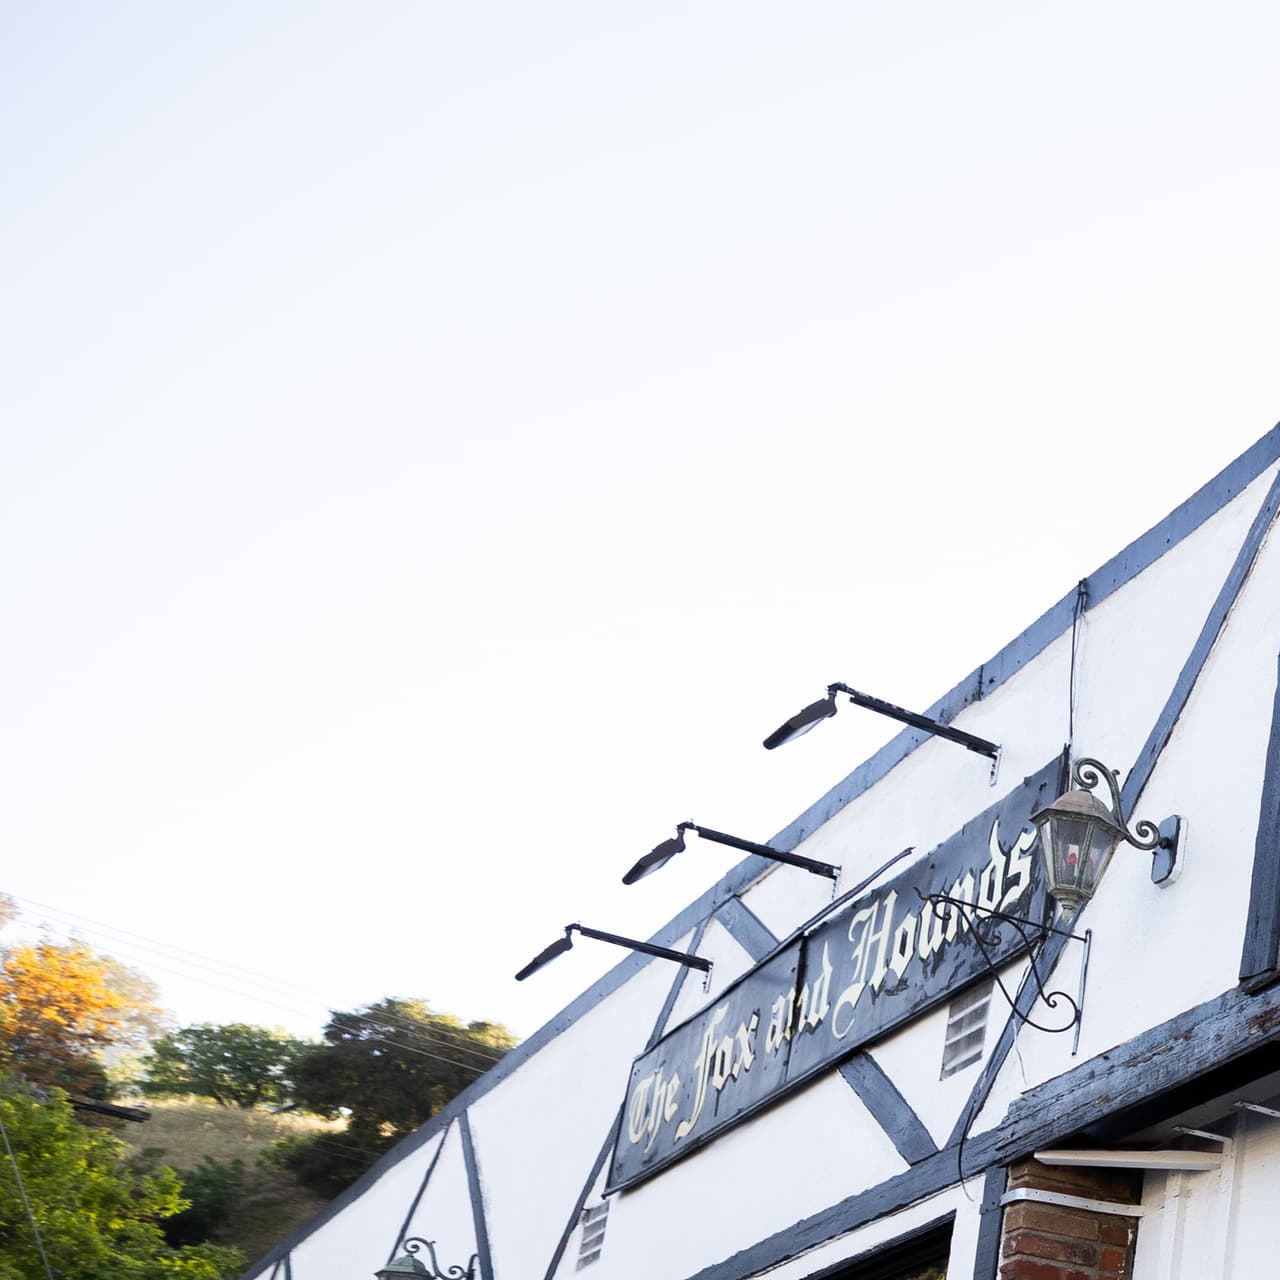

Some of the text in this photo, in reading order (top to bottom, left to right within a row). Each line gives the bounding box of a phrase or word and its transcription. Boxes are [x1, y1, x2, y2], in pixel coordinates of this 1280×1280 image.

[628, 1066, 681, 1153] The
[765, 940, 832, 1053] and
[832, 818, 1038, 1041] Hounds
